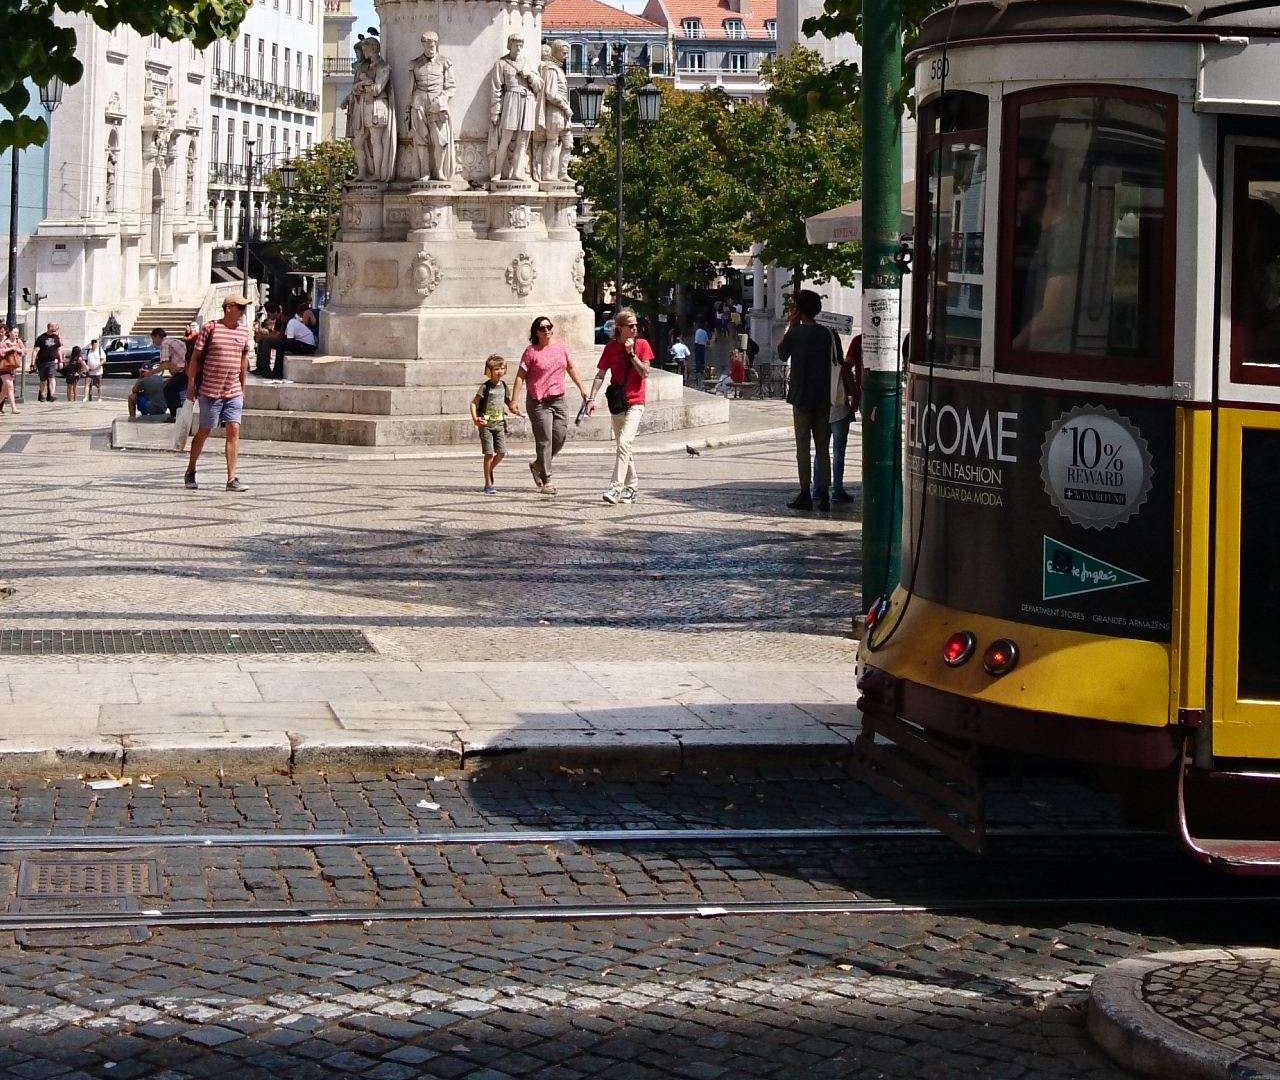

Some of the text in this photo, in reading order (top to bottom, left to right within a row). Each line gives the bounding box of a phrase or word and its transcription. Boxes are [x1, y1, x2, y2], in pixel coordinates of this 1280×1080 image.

[931, 58, 949, 80] 580
[909, 400, 1019, 463] ELCOME
[942, 461, 952, 478] IN
[954, 463, 1002, 485] FASHION
[1067, 468, 1124, 487] REWARD
[940, 485, 960, 501] LUGAR
[961, 489, 973, 503] DA
[974, 492, 1004, 508] MODA
[1095, 492, 1125, 503] REFUND
[1081, 562, 1117, 584] Inglés
[1021, 603, 1060, 618] DEPARTMENT
[1060, 609, 1085, 621] STORES
[1092, 614, 1127, 626] GRANDES
[1128, 617, 1170, 631] ARMAZÉNS
